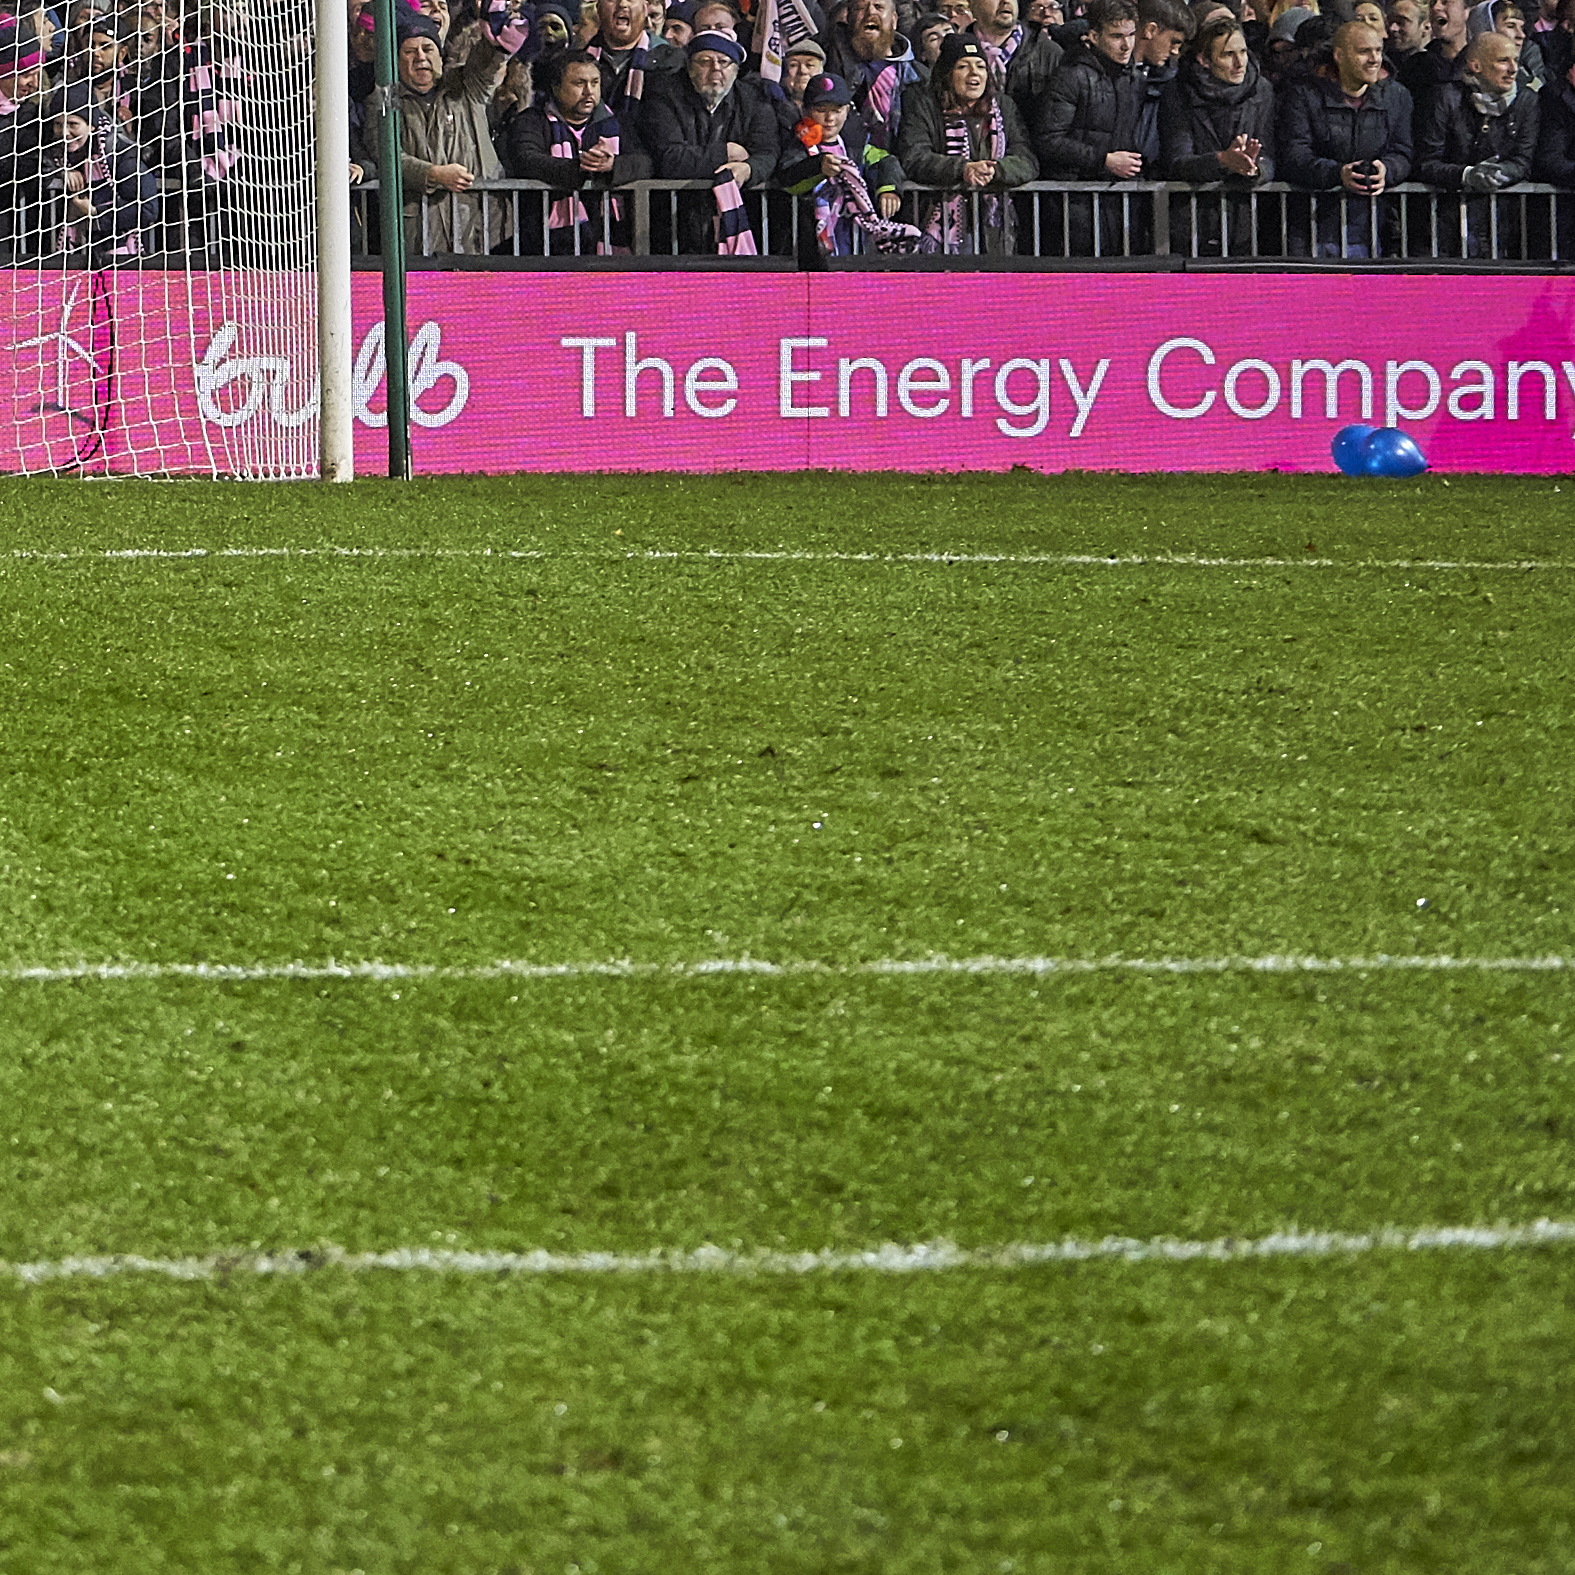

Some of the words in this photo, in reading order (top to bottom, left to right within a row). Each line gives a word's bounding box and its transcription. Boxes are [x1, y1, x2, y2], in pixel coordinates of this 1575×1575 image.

[560, 331, 739, 418] The
[779, 337, 1110, 438] Energy
[1146, 337, 1575, 439] Compan
